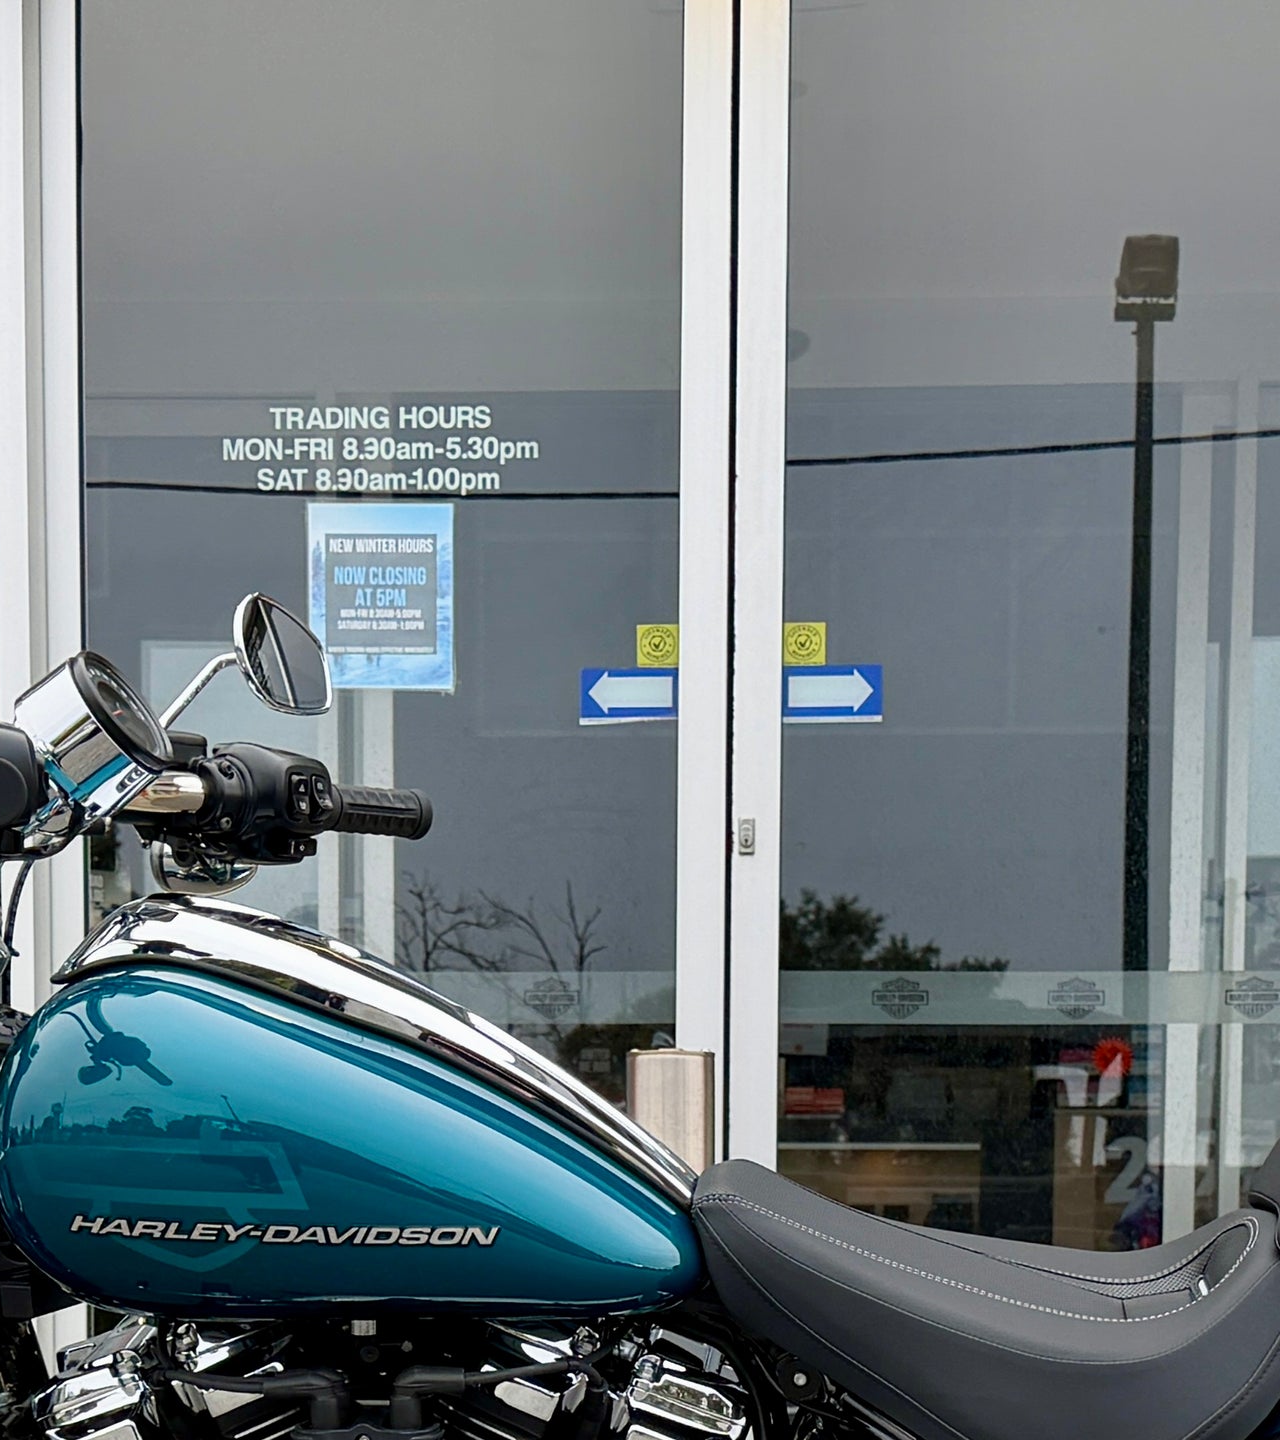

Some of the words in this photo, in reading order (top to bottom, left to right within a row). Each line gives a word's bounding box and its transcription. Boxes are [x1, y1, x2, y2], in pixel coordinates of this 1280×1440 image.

[270, 406, 390, 431] TRADING
[398, 405, 492, 430] HOURS
[222, 438, 334, 462] MON-FRI
[342, 437, 540, 465] 8.30am-5.30pm
[256, 468, 309, 492] SAT
[315, 467, 501, 496] 8.30am-1.00pm
[329, 538, 355, 554] NEW
[355, 538, 397, 554] WINTER
[398, 537, 434, 553] HOURS
[334, 566, 367, 585] NOW
[368, 566, 427, 585] CLOSING
[354, 588, 374, 607] AT
[69, 1215, 501, 1247] HARLEY-DAVIDSON
